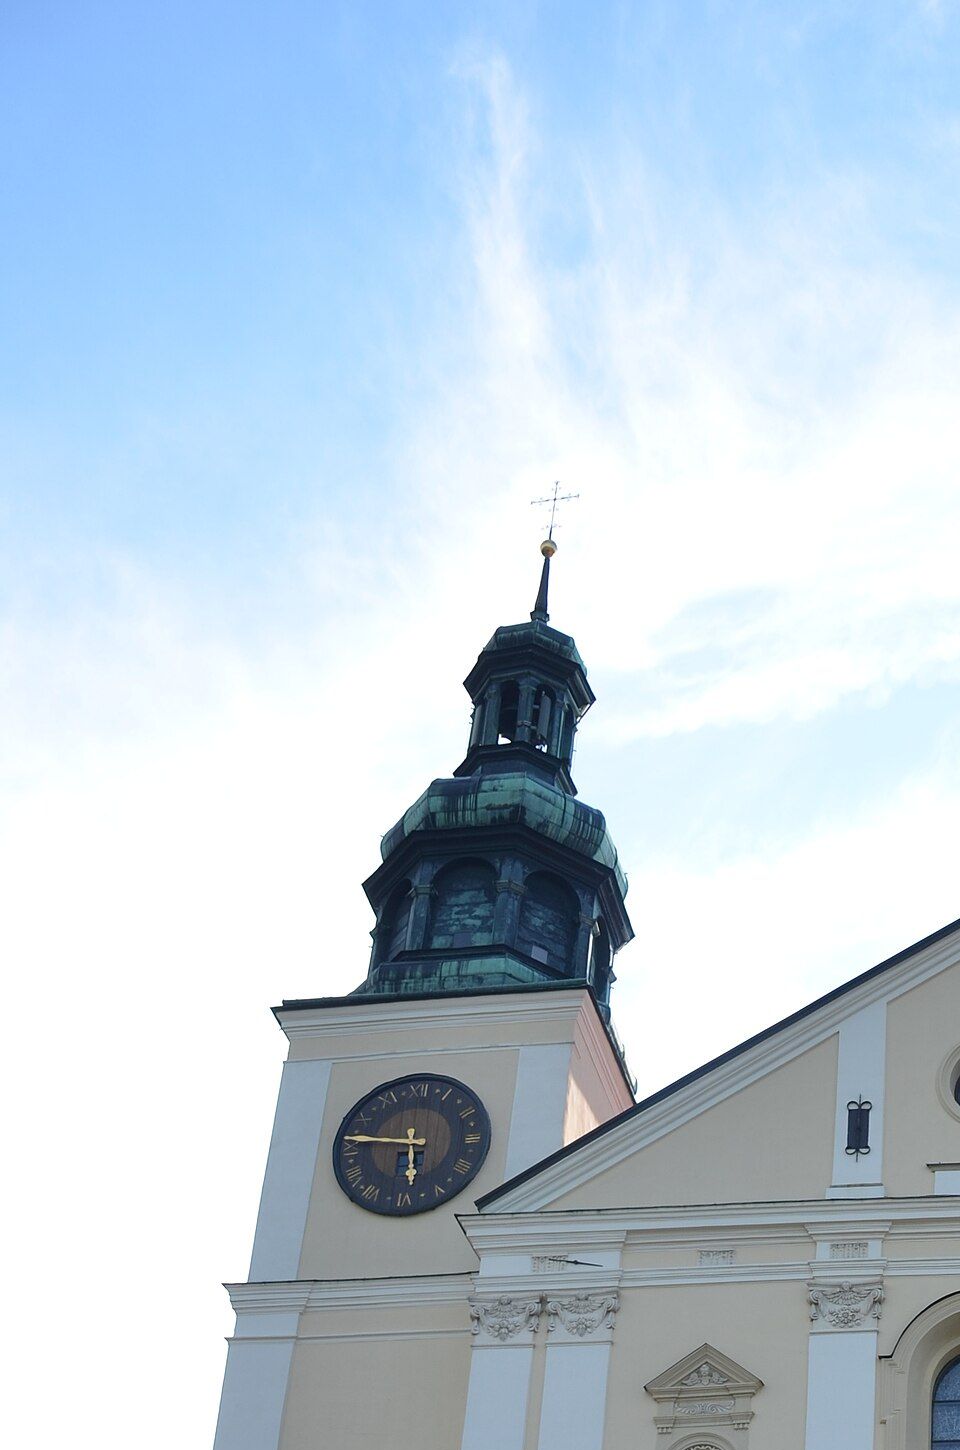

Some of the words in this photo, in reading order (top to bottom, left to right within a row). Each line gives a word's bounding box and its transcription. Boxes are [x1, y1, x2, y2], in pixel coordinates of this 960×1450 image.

[409, 1083, 429, 1098] XII
[378, 1091, 398, 1109] XI
[354, 1112, 372, 1126] X
[459, 1107, 475, 1119] II
[465, 1133, 481, 1144] III
